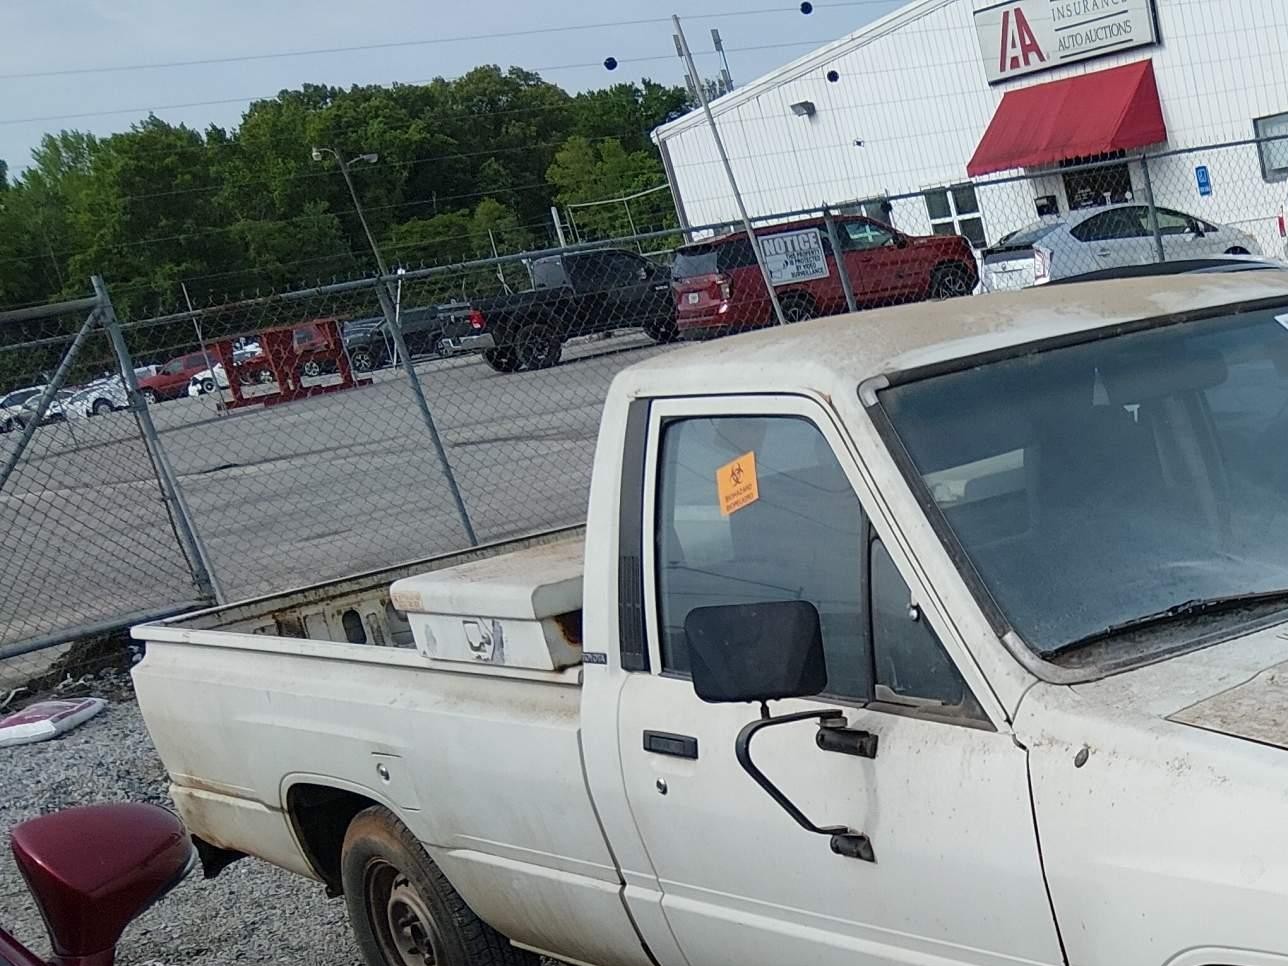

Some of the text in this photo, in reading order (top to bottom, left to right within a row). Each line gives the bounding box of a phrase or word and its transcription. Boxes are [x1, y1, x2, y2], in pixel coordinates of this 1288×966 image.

[1051, 0, 1128, 22] INSURAN
[1057, 19, 1133, 52] AUTO AUCTIONS
[762, 232, 820, 257] NOTICE
